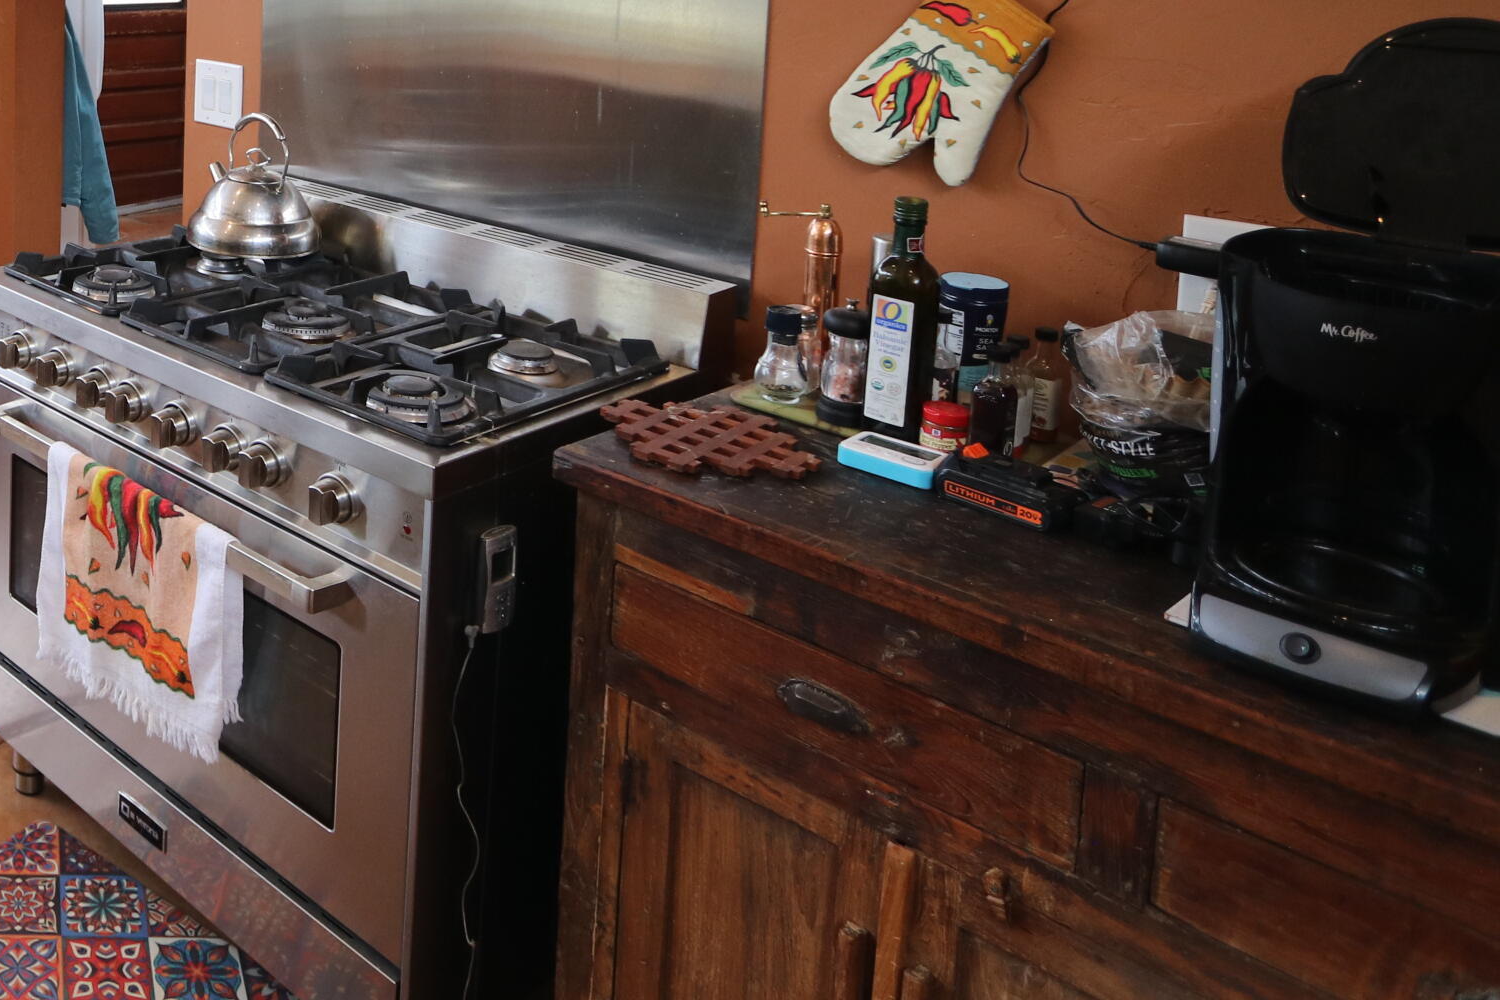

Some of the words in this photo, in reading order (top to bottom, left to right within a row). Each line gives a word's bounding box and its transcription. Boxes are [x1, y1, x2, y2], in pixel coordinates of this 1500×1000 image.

[1320, 322, 1339, 337] Mr.
[1341, 325, 1378, 343] Coffee
[948, 484, 996, 506] LITHIUM
